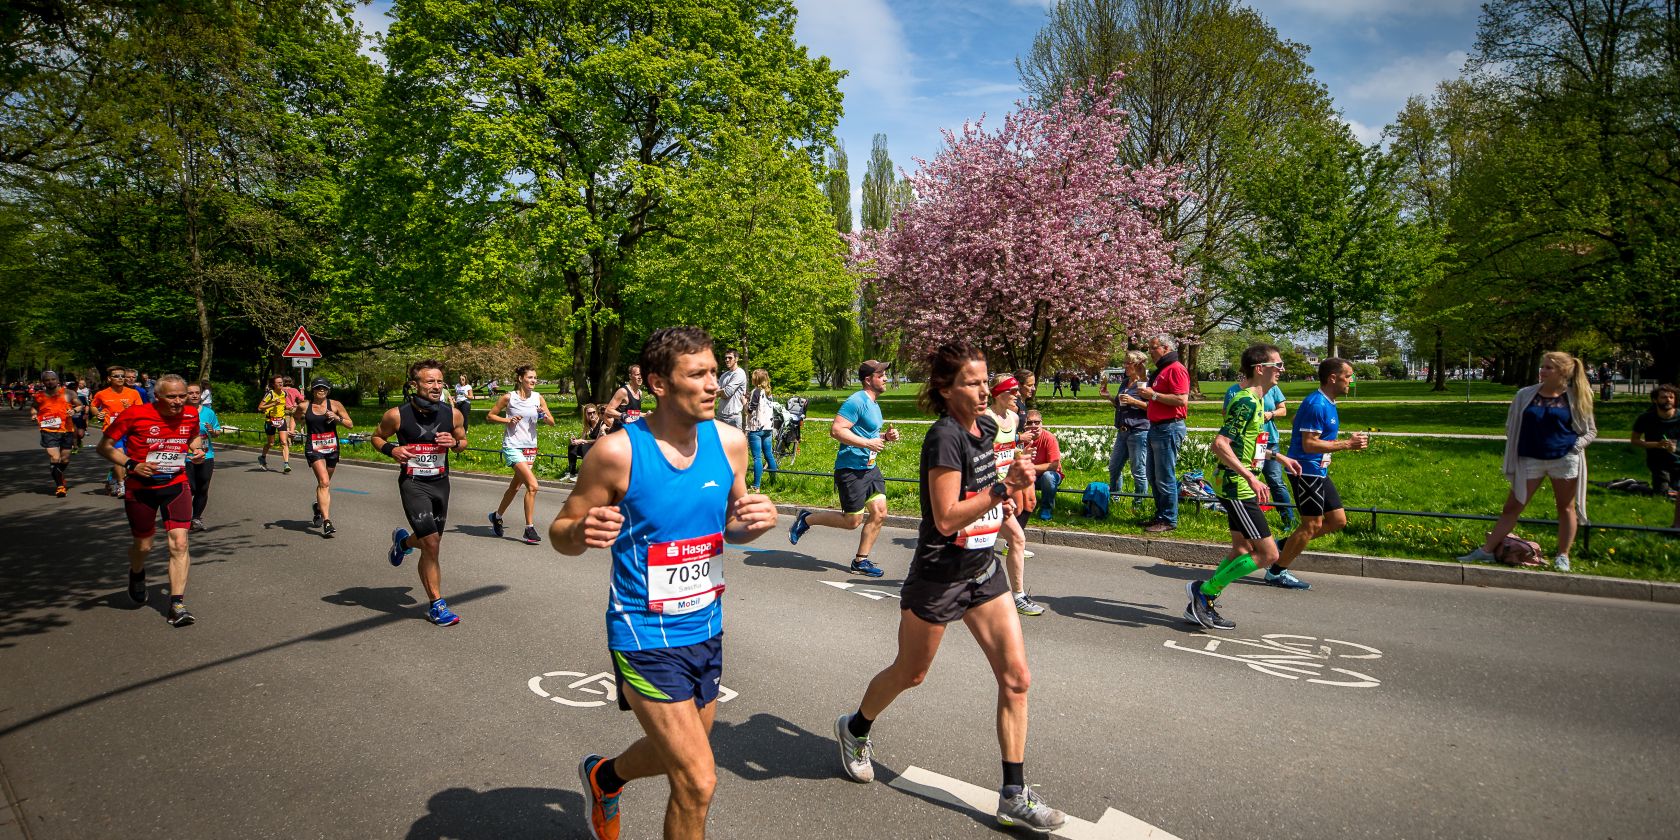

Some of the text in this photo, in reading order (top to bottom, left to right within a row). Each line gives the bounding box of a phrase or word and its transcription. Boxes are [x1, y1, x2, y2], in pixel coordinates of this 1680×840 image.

[155, 452, 179, 461] 7538
[682, 542, 712, 556] Haspa
[666, 562, 710, 584] 7030
[677, 598, 700, 608] Mobil
